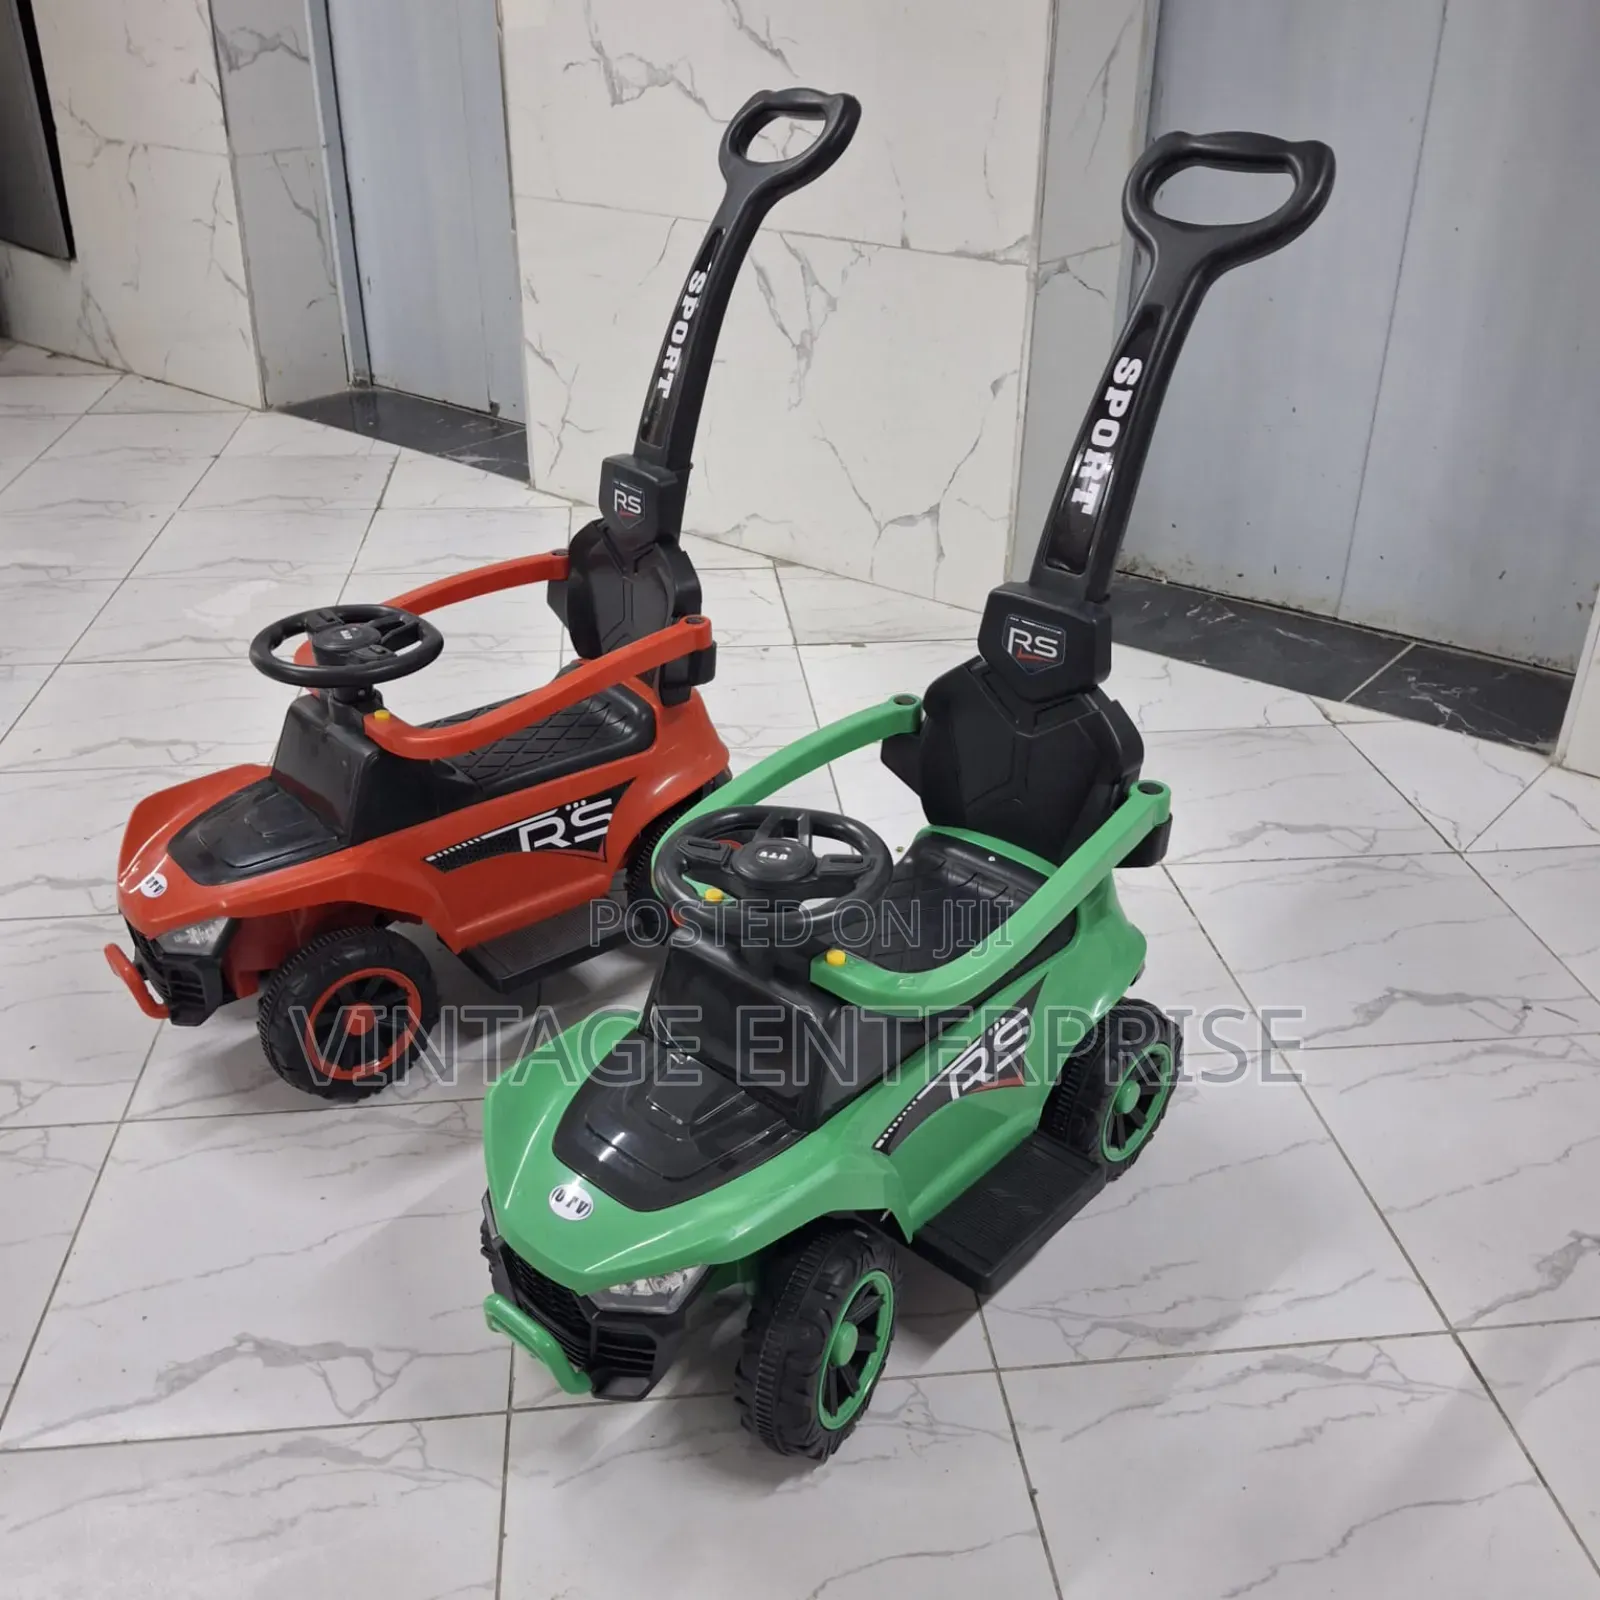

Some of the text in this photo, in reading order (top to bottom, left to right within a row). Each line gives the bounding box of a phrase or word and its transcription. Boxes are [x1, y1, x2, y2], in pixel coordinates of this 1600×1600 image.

[656, 269, 707, 399] SPORT
[1071, 356, 1143, 515] SPORT
[613, 488, 642, 514] RS
[1007, 626, 1058, 658] RS
[517, 797, 613, 853] RS
[950, 1007, 1030, 1101] RS
